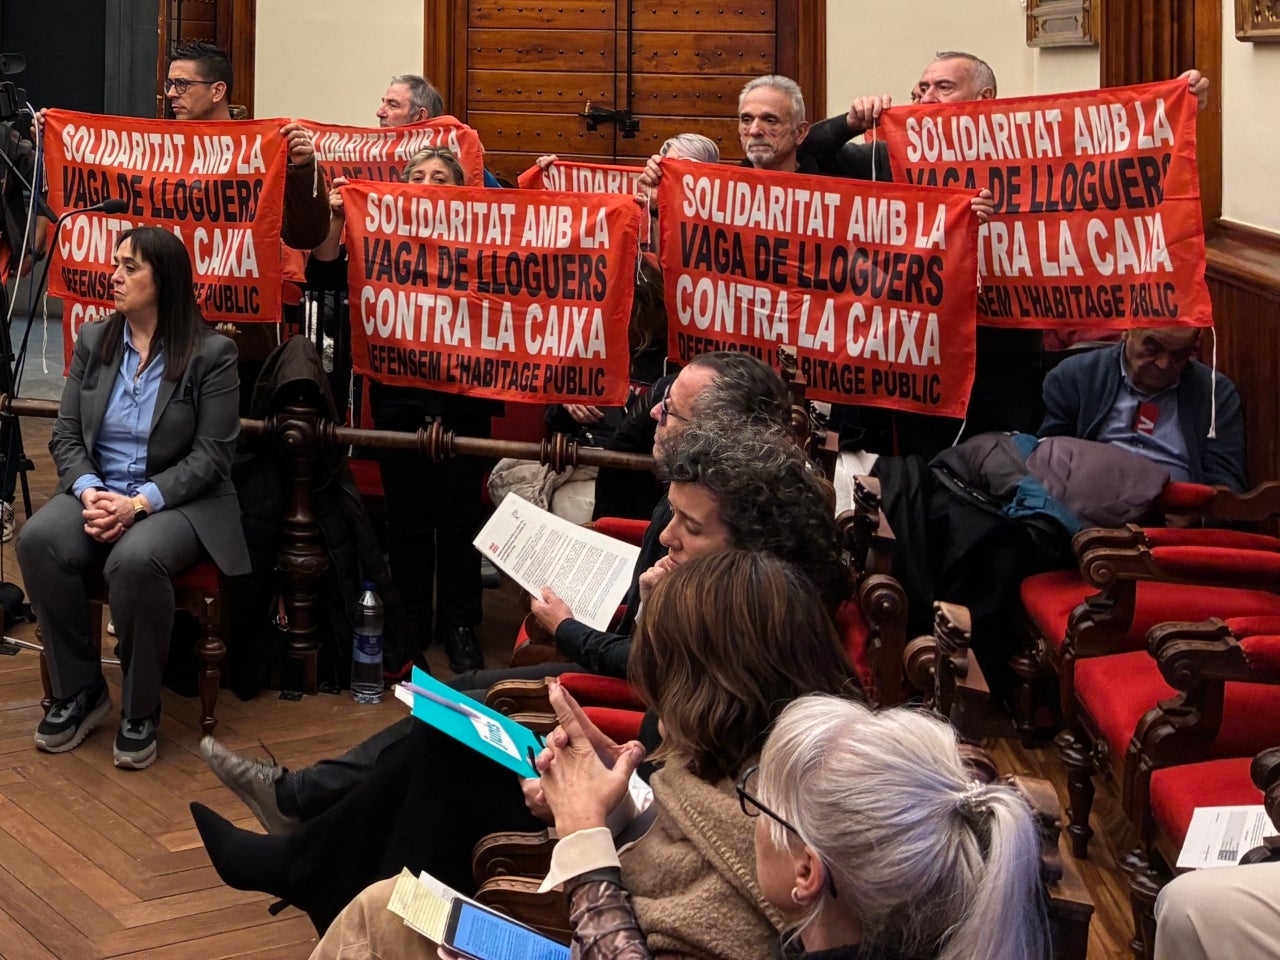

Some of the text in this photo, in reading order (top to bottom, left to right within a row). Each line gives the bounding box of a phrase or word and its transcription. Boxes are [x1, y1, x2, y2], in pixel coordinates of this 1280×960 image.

[62, 123, 266, 175] SOLIDARITAT AMB LA
[906, 98, 1174, 162] SOLIDARITAT AMB LA
[62, 165, 264, 224] VAGA DE LLOGUERS
[542, 165, 639, 196] SOLIDARIT
[989, 165, 1021, 215] DE
[365, 192, 610, 249] SOLIDARITAT AMB LA
[682, 174, 946, 249] SOLIDARITAT AMB LA
[194, 226, 259, 279] CAIXA
[363, 236, 608, 303] VAGA DE LLOGUERS
[680, 221, 747, 278] VAGA
[754, 235, 789, 285] DE
[797, 239, 944, 307] LLOGUERS
[978, 220, 1033, 278] TRA
[1038, 219, 1081, 278] LA
[205, 276, 260, 316] PÚBLIC
[360, 285, 607, 360] CONTRA LA CAIXA
[676, 273, 789, 345] CONTRA
[798, 294, 835, 353] LA
[846, 301, 941, 367] CAIXA
[1019, 284, 1125, 320] L'HABITAGE
[447, 352, 539, 392] L'HABITAGE
[543, 357, 606, 397] PÚBLIC
[871, 363, 941, 406] PÚBLIC
